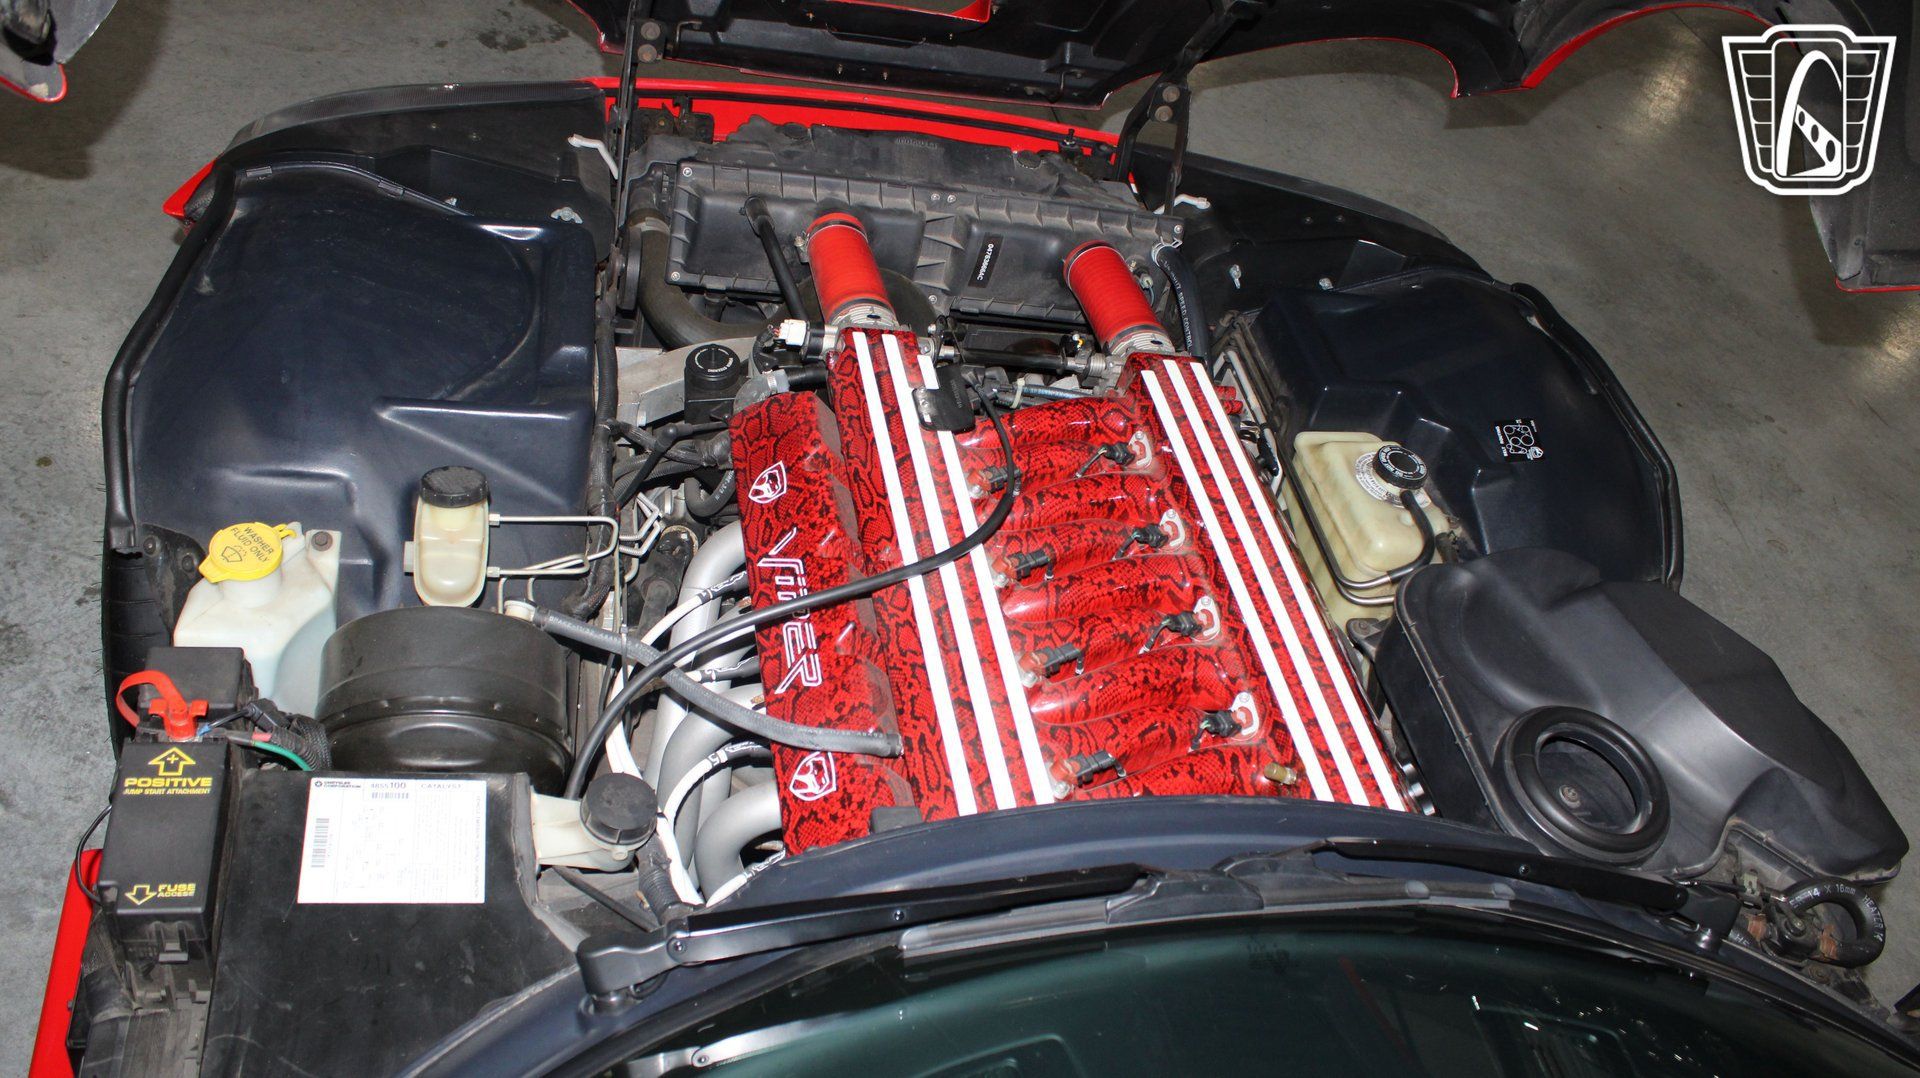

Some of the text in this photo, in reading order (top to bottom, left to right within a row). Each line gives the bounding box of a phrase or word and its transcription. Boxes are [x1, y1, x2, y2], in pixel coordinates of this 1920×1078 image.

[1179, 292, 1193, 349] SPEED CONTROL
[231, 527, 270, 562] FLUID ONLY
[244, 527, 274, 554] WASHER
[124, 777, 213, 788] POSITIVE
[158, 883, 196, 893] FUSE
[1808, 887, 1820, 899] 14
[1836, 883, 1856, 895] 16mm
[1862, 894, 1884, 928] HEATER
